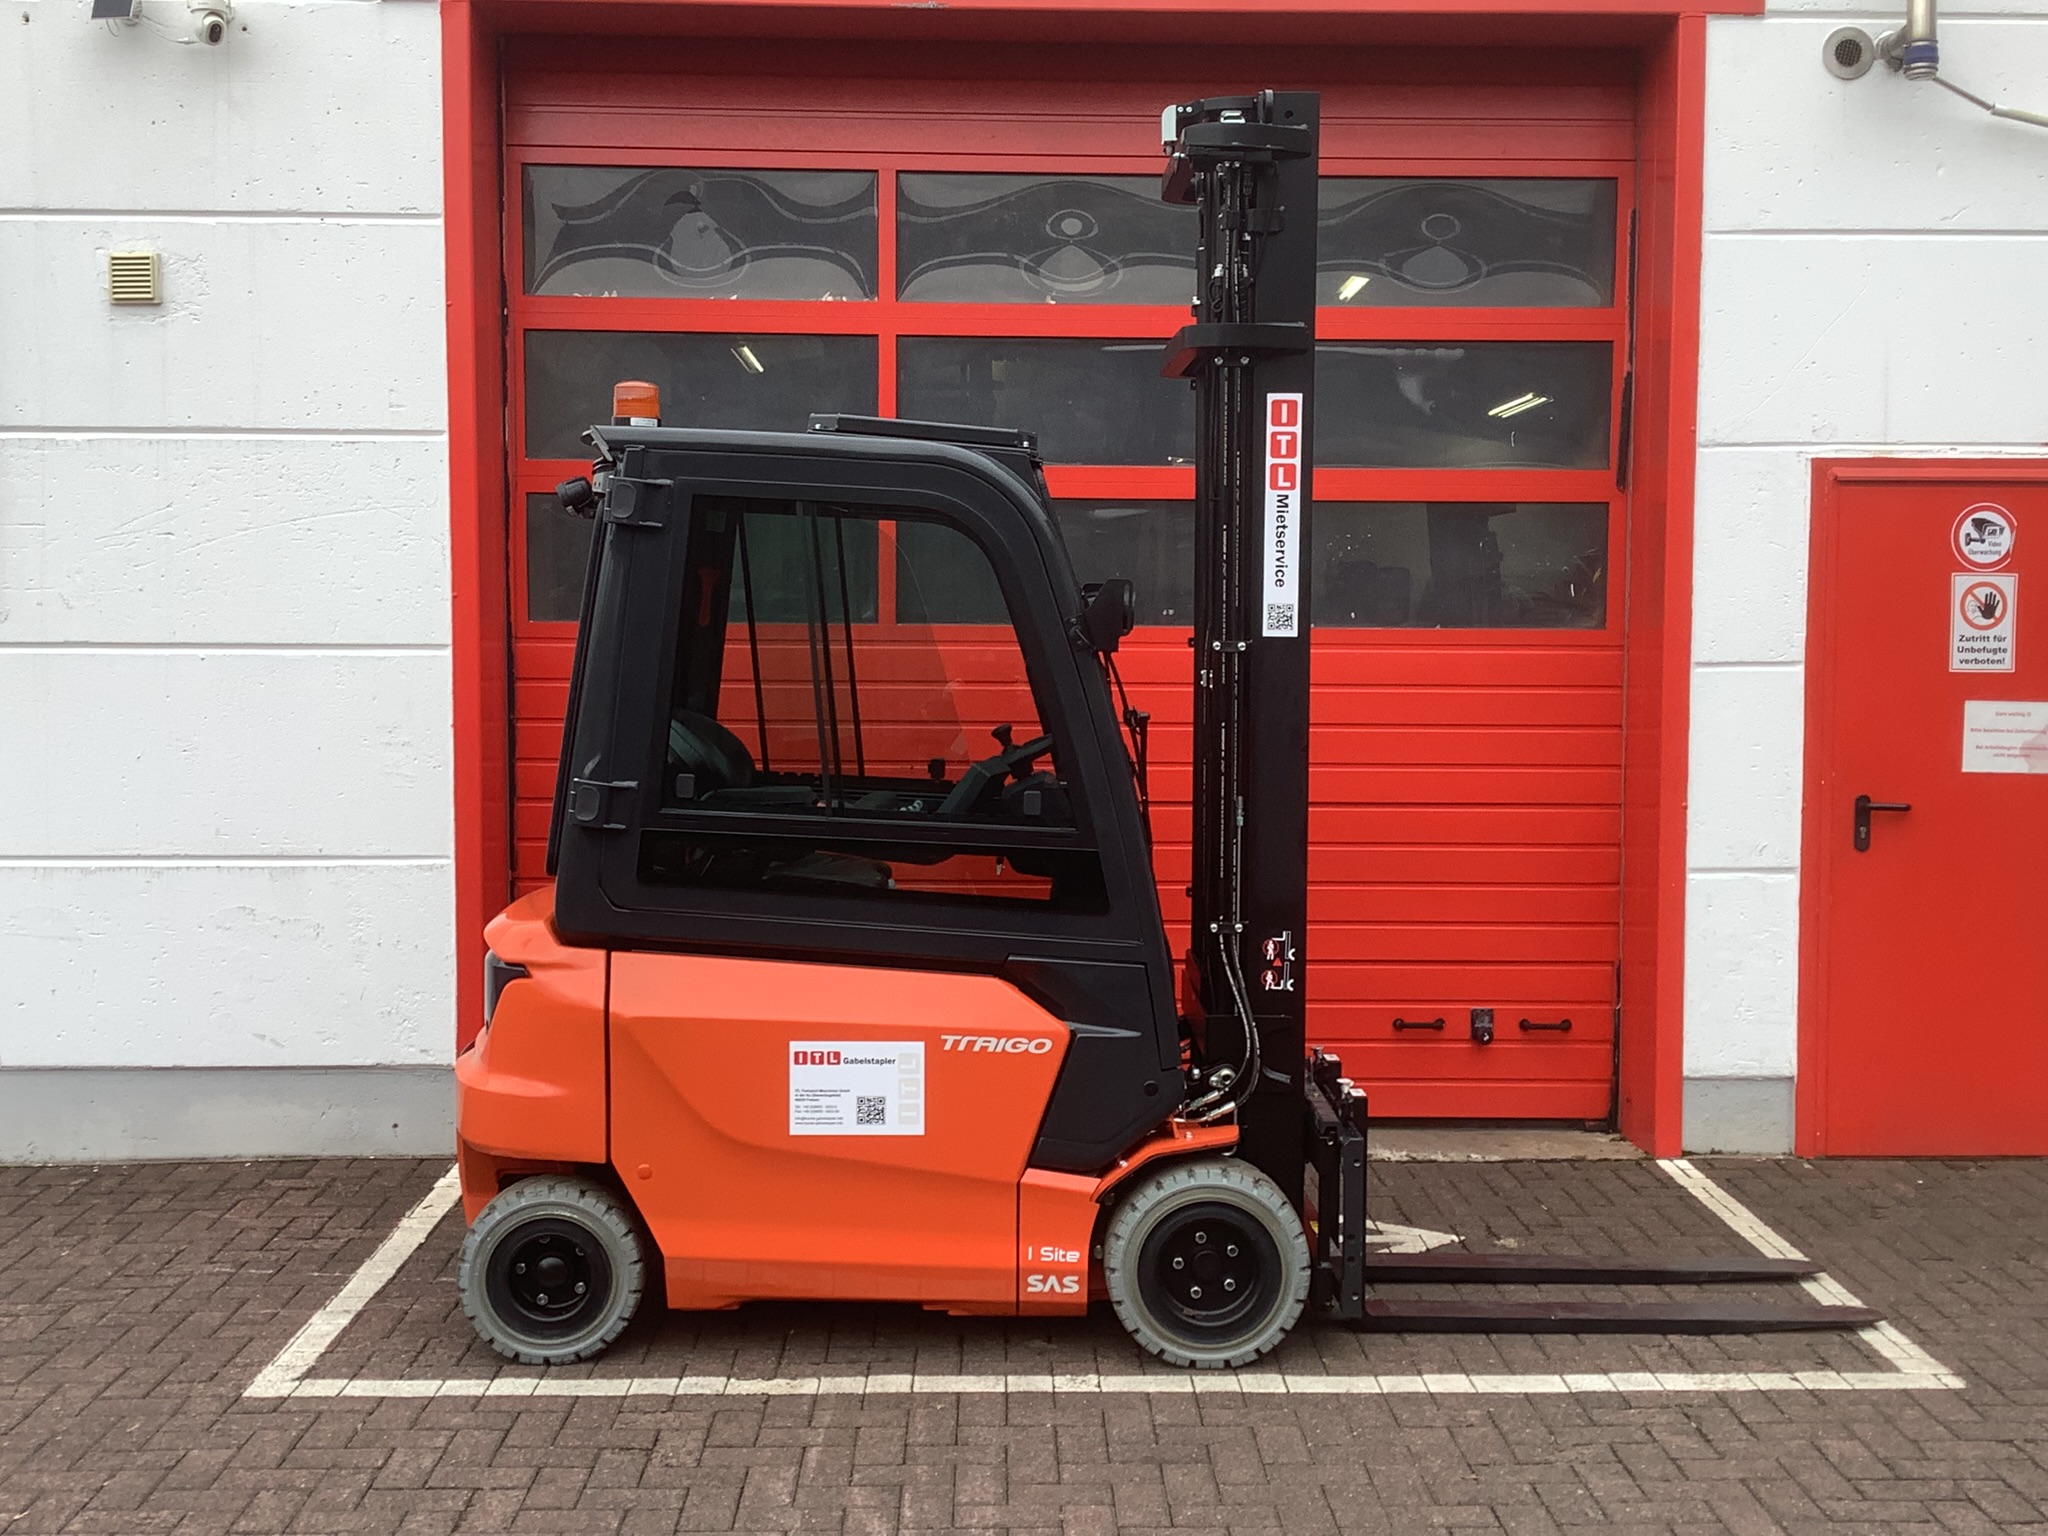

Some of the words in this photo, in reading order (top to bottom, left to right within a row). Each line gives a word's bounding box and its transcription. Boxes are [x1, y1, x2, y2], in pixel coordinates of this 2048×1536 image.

[1272, 401, 1295, 489] ITL
[1274, 494, 1289, 588] Mietservice
[1958, 634, 1990, 642] Zutritt
[1993, 634, 2007, 642] für
[1957, 646, 2008, 655] Unbefugte
[1959, 657, 2006, 665] verboten!
[940, 1034, 1053, 1054] TRAIGO
[796, 1052, 839, 1064] ITL
[843, 1057, 896, 1066] Gabelstapler
[1040, 1246, 1080, 1262] Site
[1027, 1274, 1079, 1293] SAS
